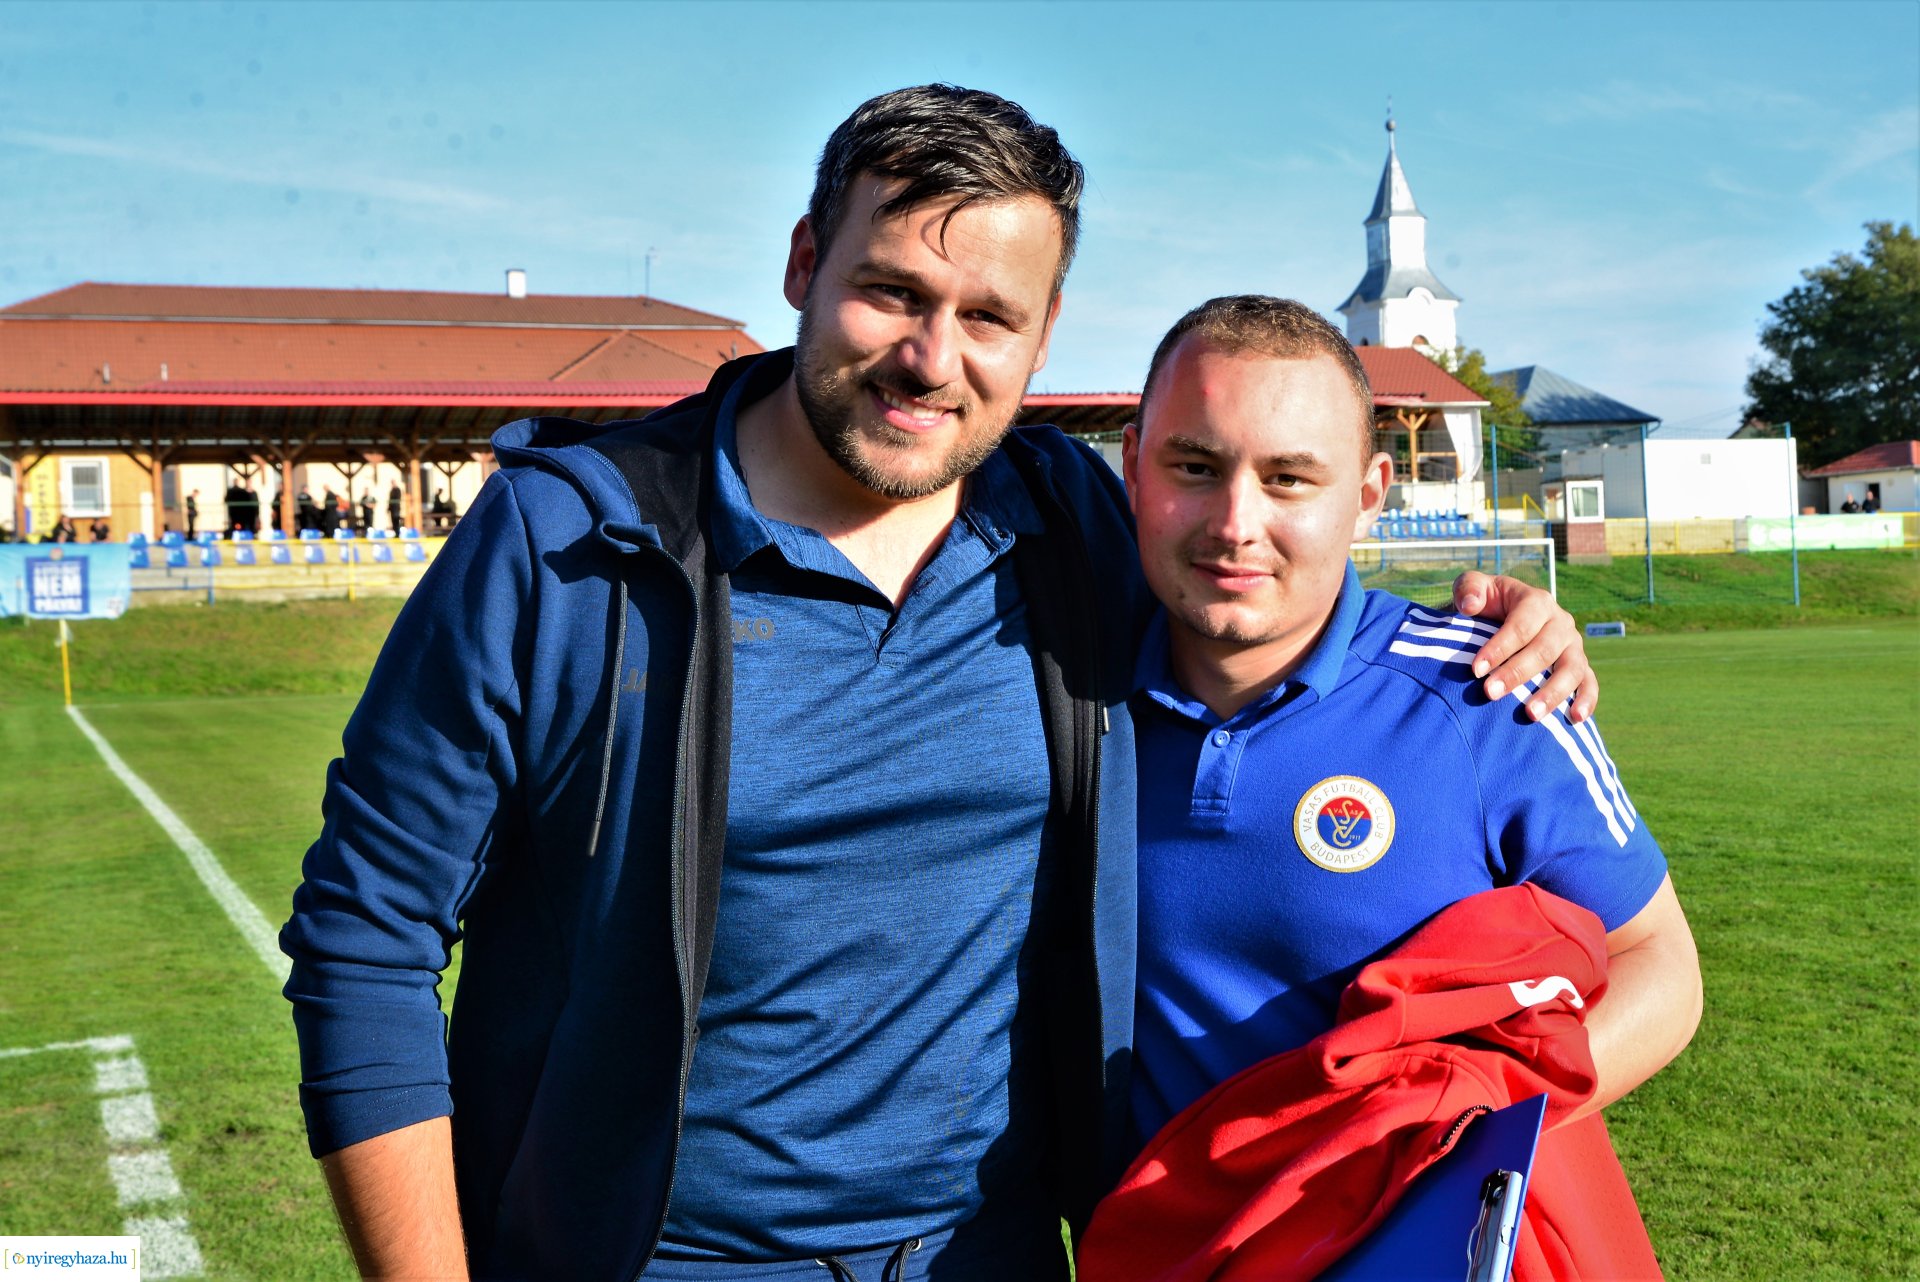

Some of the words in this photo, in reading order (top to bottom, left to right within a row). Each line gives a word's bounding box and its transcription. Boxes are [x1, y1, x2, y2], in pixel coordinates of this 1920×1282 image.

[33, 575, 82, 597] NEM
[1303, 796, 1322, 832] VASAS
[1323, 783, 1376, 805] FUTBALL
[1374, 807, 1385, 839] CLUB
[1310, 842, 1372, 864] BUDAPEST
